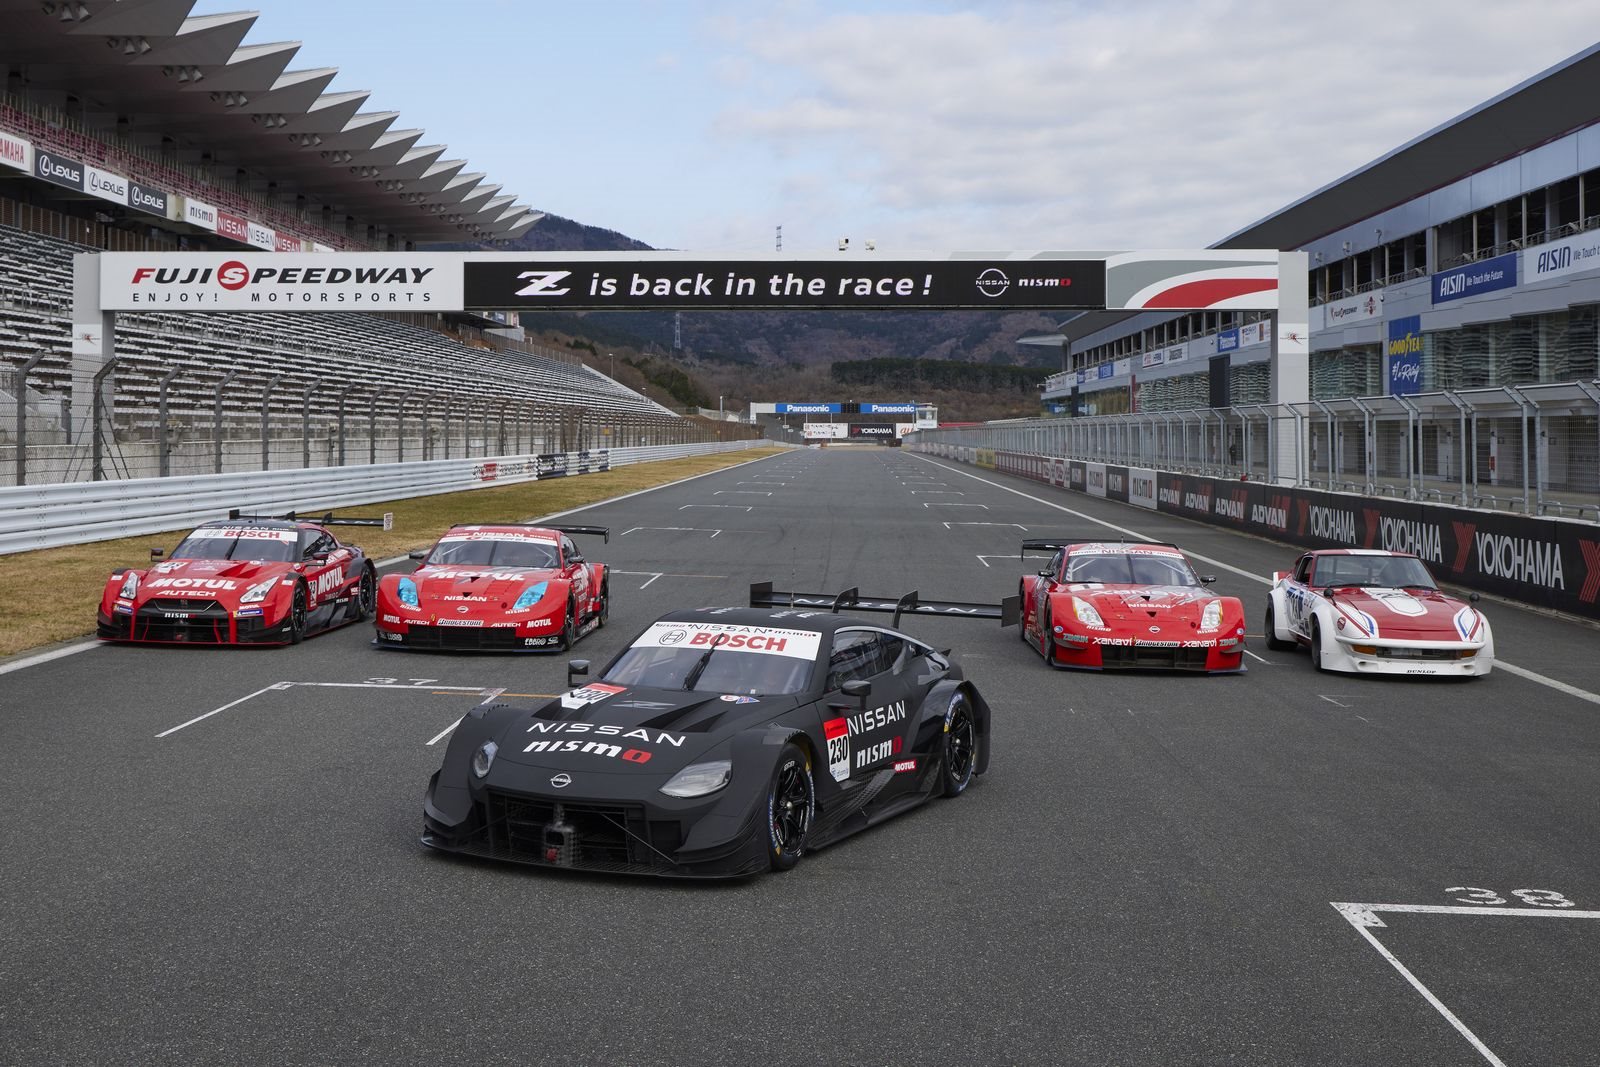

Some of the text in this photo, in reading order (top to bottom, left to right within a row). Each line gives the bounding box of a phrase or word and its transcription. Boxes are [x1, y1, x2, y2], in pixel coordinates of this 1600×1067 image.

[50, 163, 80, 183] LEXUS
[99, 178, 124, 196] LEXUS
[140, 192, 164, 209] LEXUS
[190, 206, 213, 223] nismo
[218, 217, 247, 238] NISSAN
[248, 228, 275, 246] NISSAN
[276, 237, 301, 252] NISSAN
[1537, 246, 1571, 274] AISIN
[589, 272, 617, 296] is
[630, 272, 712, 296] back
[724, 272, 756, 296] in
[767, 272, 825, 296] the
[974, 279, 1010, 287] NISSAN
[1017, 277, 1072, 287] nismo
[1440, 273, 1465, 297] AISIN
[132, 292, 431, 302] ENJOY! MOTORSPORTS
[787, 404, 830, 413] Panasonic
[872, 404, 915, 413] Panasonic
[1159, 489, 1180, 505] ADVAN
[1185, 491, 1210, 512] ADVAN
[1215, 497, 1244, 520] ADVAN
[1251, 504, 1287, 529] ADVAN
[224, 530, 281, 539] BOSCH
[1308, 504, 1356, 545] YOKOHAMA
[1379, 515, 1443, 564] YOKOHAMA
[1475, 530, 1565, 591] YOKOHAMA
[146, 578, 237, 590] MOTUL
[318, 566, 344, 595] MOTUL
[428, 571, 526, 581] MOTUL
[383, 613, 401, 624] MOTUL
[526, 618, 552, 629] MOTUL
[691, 623, 768, 634] NISSAN
[689, 631, 788, 652] BOSCH
[363, 677, 438, 685] 37
[847, 700, 906, 737] NISSAN
[527, 722, 686, 747] NISSAN
[522, 740, 652, 764] nismo
[830, 736, 848, 766] 230
[856, 736, 903, 769] nismo
[894, 761, 917, 773] MOTUL
[1445, 886, 1576, 908] 38
